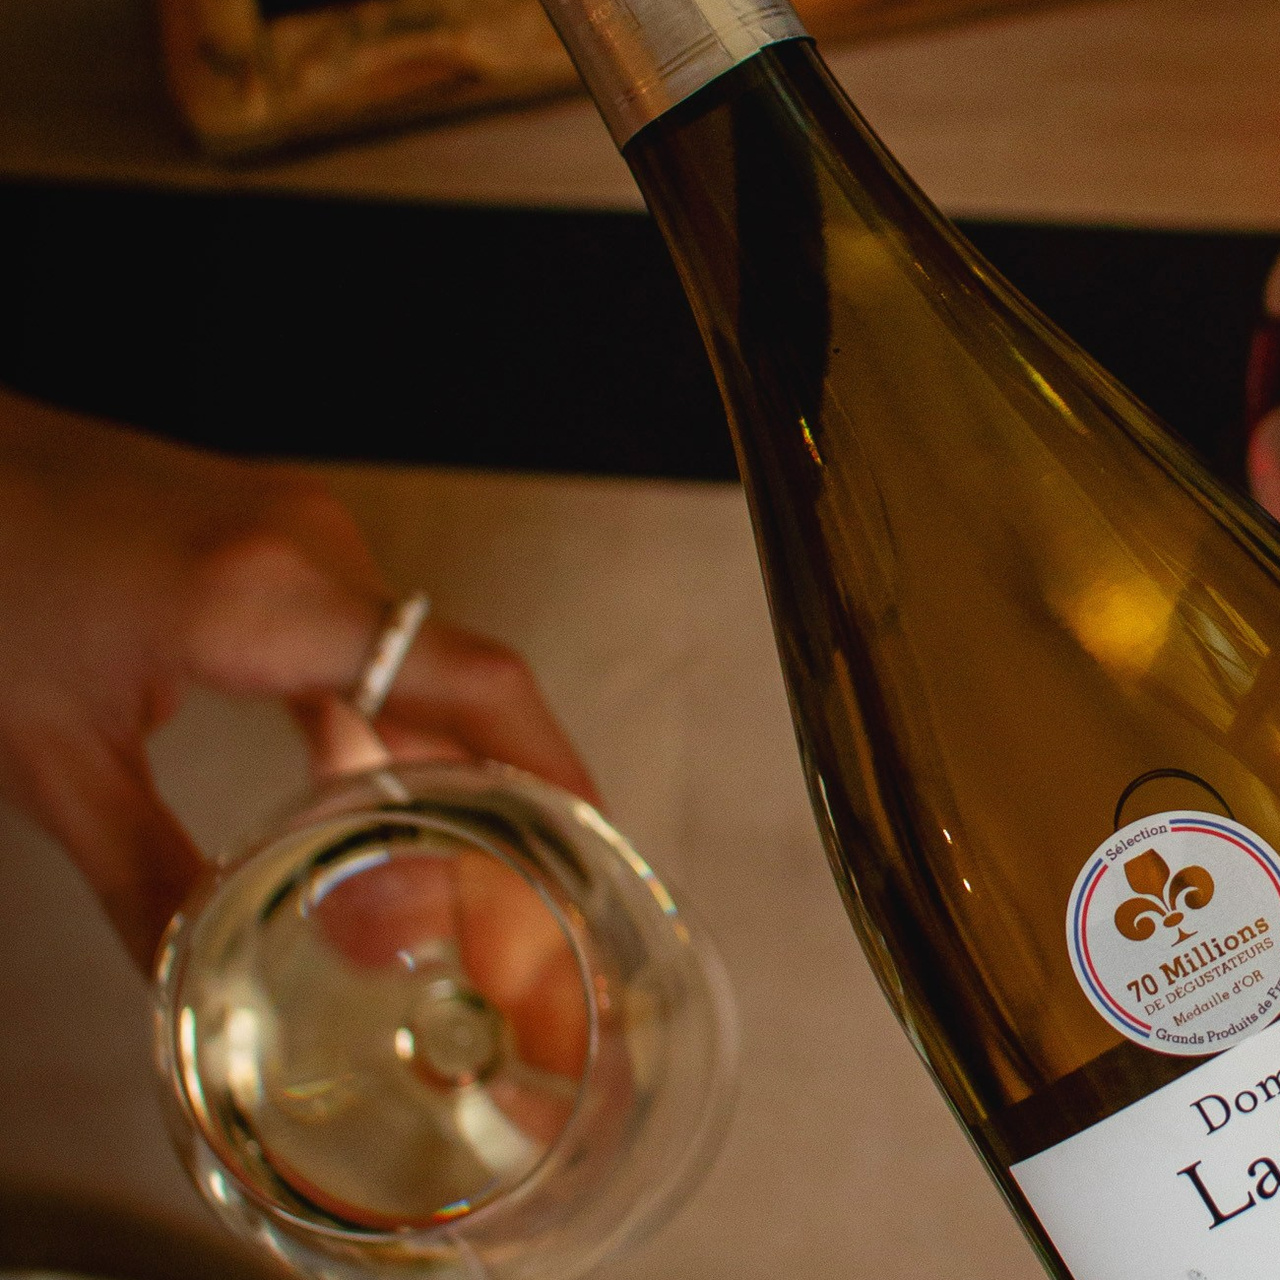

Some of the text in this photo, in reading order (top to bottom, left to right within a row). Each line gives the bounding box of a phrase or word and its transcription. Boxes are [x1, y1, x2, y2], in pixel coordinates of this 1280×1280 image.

[1105, 825, 1168, 861] Sélection
[1127, 917, 1269, 1002] 70 Millions
[1144, 937, 1274, 1016] DE DÉGUSTATEURS
[1231, 970, 1264, 995] d'OR
[1155, 1028, 1204, 1045] Grands
[1207, 1012, 1259, 1042] Produits
[1257, 999, 1272, 1015] de
